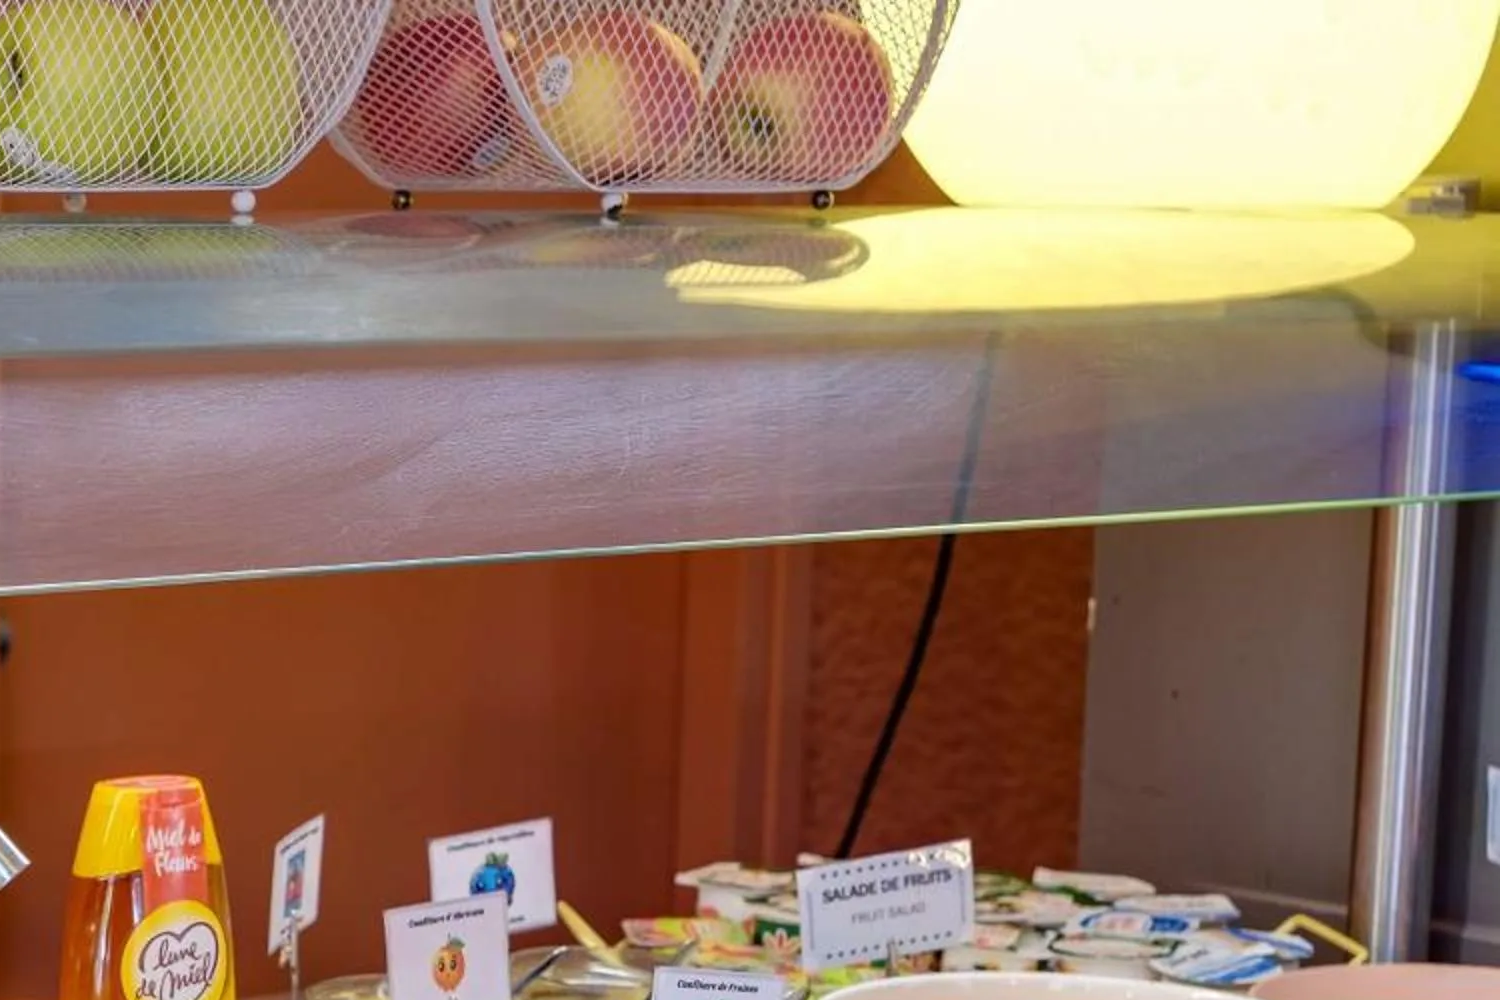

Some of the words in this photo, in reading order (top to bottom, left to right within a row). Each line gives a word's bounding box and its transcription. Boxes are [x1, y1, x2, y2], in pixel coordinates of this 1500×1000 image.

[146, 818, 186, 853] Miel
[822, 879, 877, 904] SALADE
[880, 877, 899, 894] DE
[903, 867, 952, 888] FRUITS
[851, 907, 886, 924] FRUIT
[887, 901, 926, 919] SALAD
